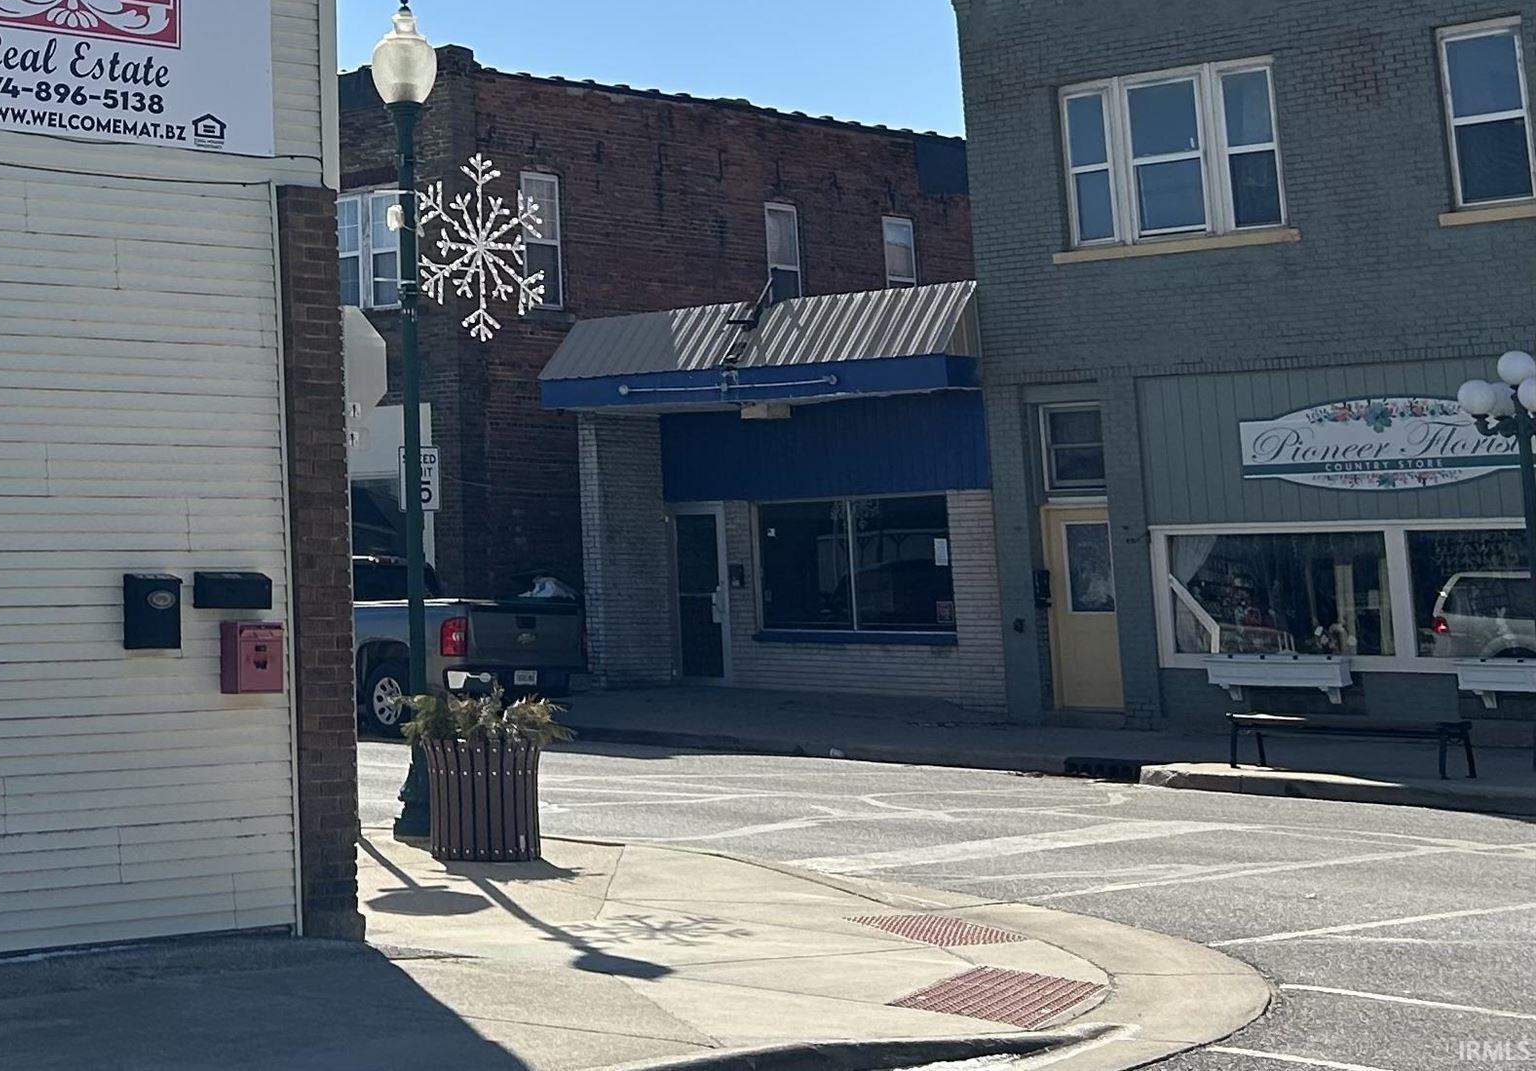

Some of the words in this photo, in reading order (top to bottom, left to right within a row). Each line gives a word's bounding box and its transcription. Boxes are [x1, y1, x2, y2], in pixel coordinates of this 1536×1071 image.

[69, 41, 170, 88] Estate
[1251, 426, 1391, 463] Pioneer
[1324, 460, 1390, 472] COUNTRY
[1398, 458, 1444, 469] STORE
